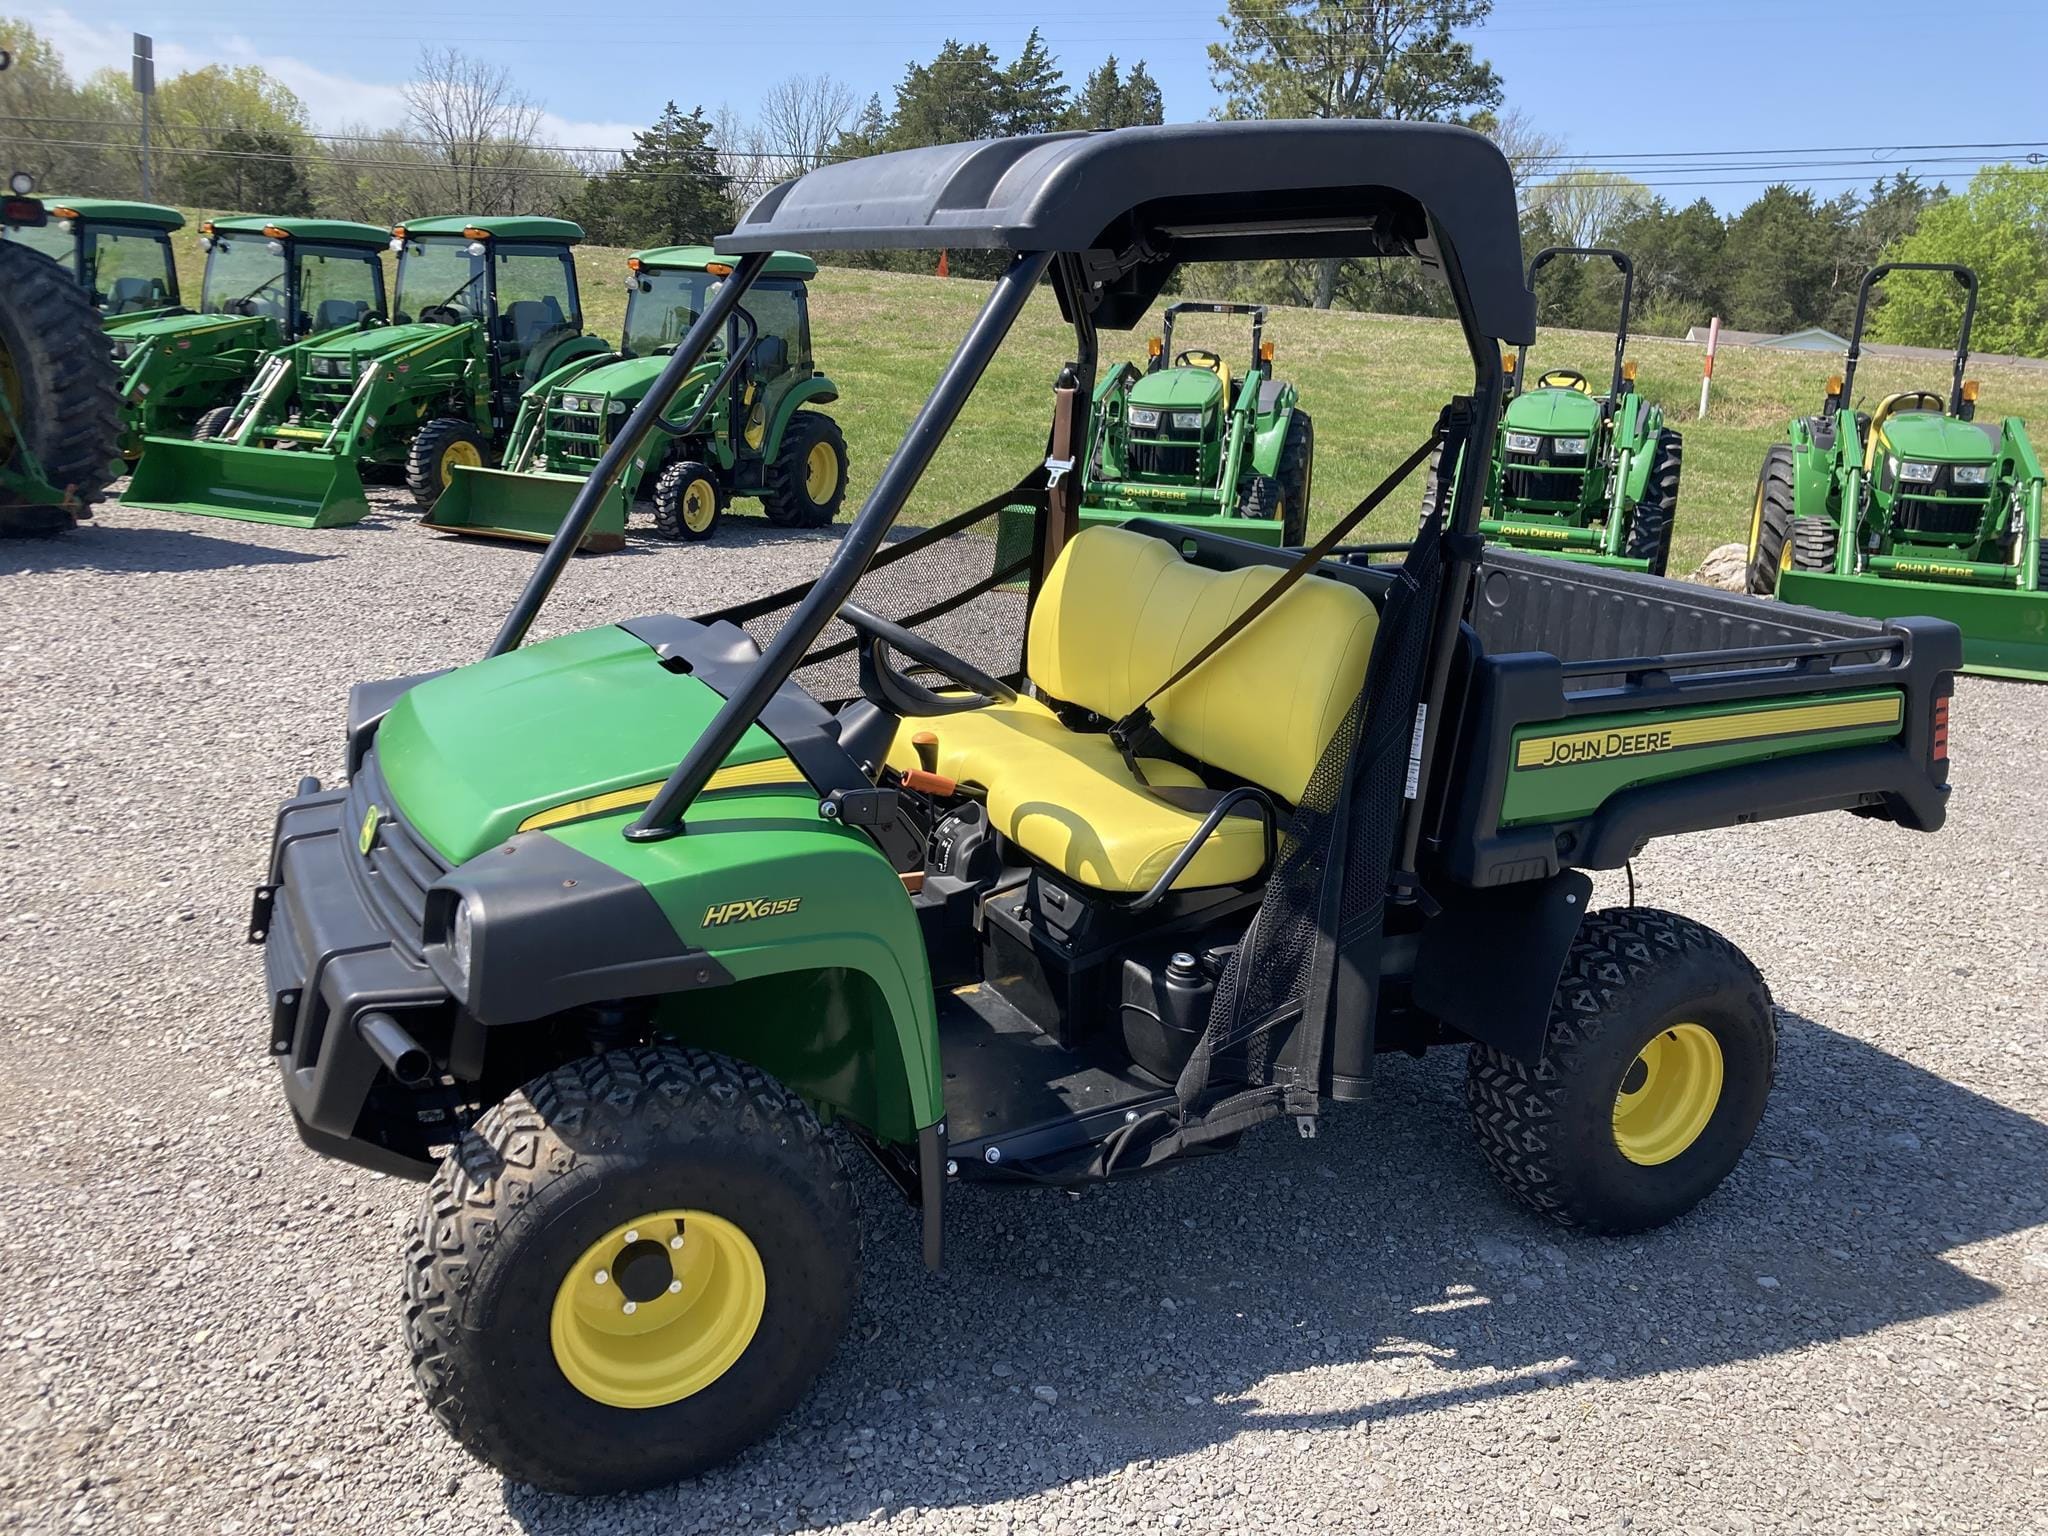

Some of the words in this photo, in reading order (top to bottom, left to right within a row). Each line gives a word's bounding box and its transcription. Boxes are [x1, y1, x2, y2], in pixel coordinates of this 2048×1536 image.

[1121, 486, 1149, 497] JOHN
[1151, 488, 1187, 499] DEERE
[1497, 525, 1528, 536] JOHN
[1530, 527, 1569, 540] DEERE
[1892, 561, 1926, 573] JOHN
[1929, 564, 1974, 576] DEERE
[1543, 740, 1601, 764] JOHN
[1605, 730, 1672, 755] DEERE
[701, 898, 801, 928] HPX615E
